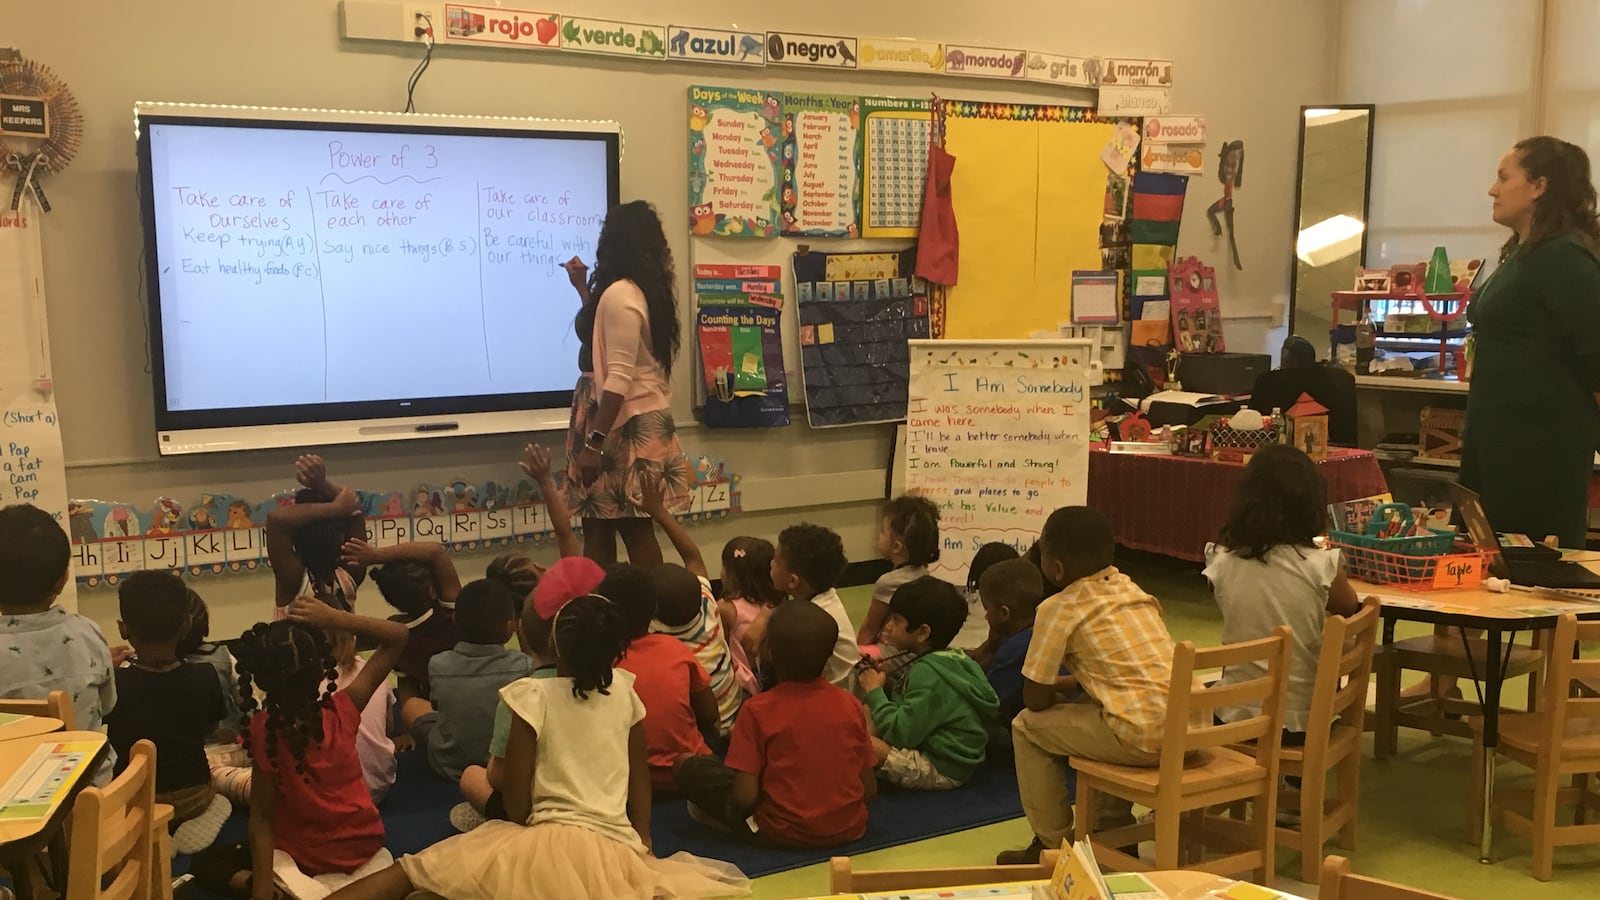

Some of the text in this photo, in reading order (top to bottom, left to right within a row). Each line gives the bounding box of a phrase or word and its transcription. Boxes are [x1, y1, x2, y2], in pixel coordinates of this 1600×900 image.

[489, 15, 534, 40] rojo
[583, 27, 636, 47] verde
[690, 34, 735, 56] azul
[787, 41, 837, 62] negro
[877, 47, 930, 62] amarillo
[965, 54, 1013, 69] morado
[1050, 59, 1077, 79] gris
[1118, 61, 1159, 77] marrón
[693, 87, 721, 104] Days
[737, 91, 763, 104] Week
[784, 95, 824, 108] Months
[830, 97, 852, 110] Year
[1119, 94, 1158, 109] blanco
[12, 104, 30, 113] MRS
[865, 98, 908, 109] Numbers
[3, 116, 42, 126] KEEPERS
[717, 118, 744, 130] Sunday
[803, 113, 828, 123] January
[802, 123, 831, 133] February
[1161, 123, 1198, 137] rosado
[712, 132, 741, 144] Monday
[803, 133, 822, 141] March
[718, 146, 748, 158] Tuesday
[803, 142, 818, 150] April
[328, 141, 438, 169] Power of 3
[803, 152, 815, 160] May
[713, 160, 754, 171] Wednesday
[719, 173, 753, 184] Thursday
[803, 171, 815, 180] July
[713, 187, 738, 197] Friday
[803, 181, 824, 190] August
[172, 187, 295, 208] Take care of
[316, 190, 432, 210] Take care of
[481, 187, 572, 206] Take care of
[803, 191, 835, 199] September
[719, 200, 753, 211] Saturday
[0, 211, 27, 228] ords
[209, 212, 291, 230] Ourselves
[328, 211, 416, 229] each other
[487, 206, 602, 226] our classroom
[183, 227, 230, 249] Keep
[483, 227, 591, 253] Be careful with
[323, 240, 353, 263] Say
[363, 243, 391, 255] nice
[488, 251, 512, 264] our
[181, 258, 211, 274] Eat
[218, 257, 262, 285] healthy
[697, 268, 712, 276] Today
[697, 282, 724, 290] Yesterday
[701, 314, 776, 327] Counting the Days
[943, 372, 1083, 403] I Am Somebody
[911, 398, 1074, 421] I was somebody when I
[4, 410, 56, 427] (Short a)
[911, 415, 975, 427] came here
[909, 430, 933, 442] I'll
[939, 431, 950, 441] be
[967, 432, 1000, 441] better
[1003, 429, 1051, 445] somebody
[1054, 429, 1080, 440] when
[910, 444, 949, 453] I leave
[4, 457, 42, 472] a fat
[908, 458, 920, 468] I
[950, 458, 992, 469] Powerful
[997, 459, 1015, 468] and
[1023, 458, 1059, 473] Strong!
[1024, 477, 1055, 488] people
[1060, 477, 1072, 487] to
[979, 487, 1007, 498] places
[1012, 488, 1021, 496] to
[1027, 489, 1039, 500] go
[961, 500, 976, 511] has
[986, 502, 1017, 514] Value
[1025, 507, 1043, 515] and
[117, 542, 129, 563] Ii
[150, 538, 178, 568] Jj
[193, 533, 221, 555] Kk
[233, 529, 252, 550] Ll
[382, 519, 406, 544] Pp
[416, 517, 448, 543] Qq
[455, 513, 477, 532] Rr
[486, 510, 507, 529] Ss
[518, 505, 538, 525] Tt
[707, 484, 726, 503] Zz
[944, 537, 963, 549] Am
